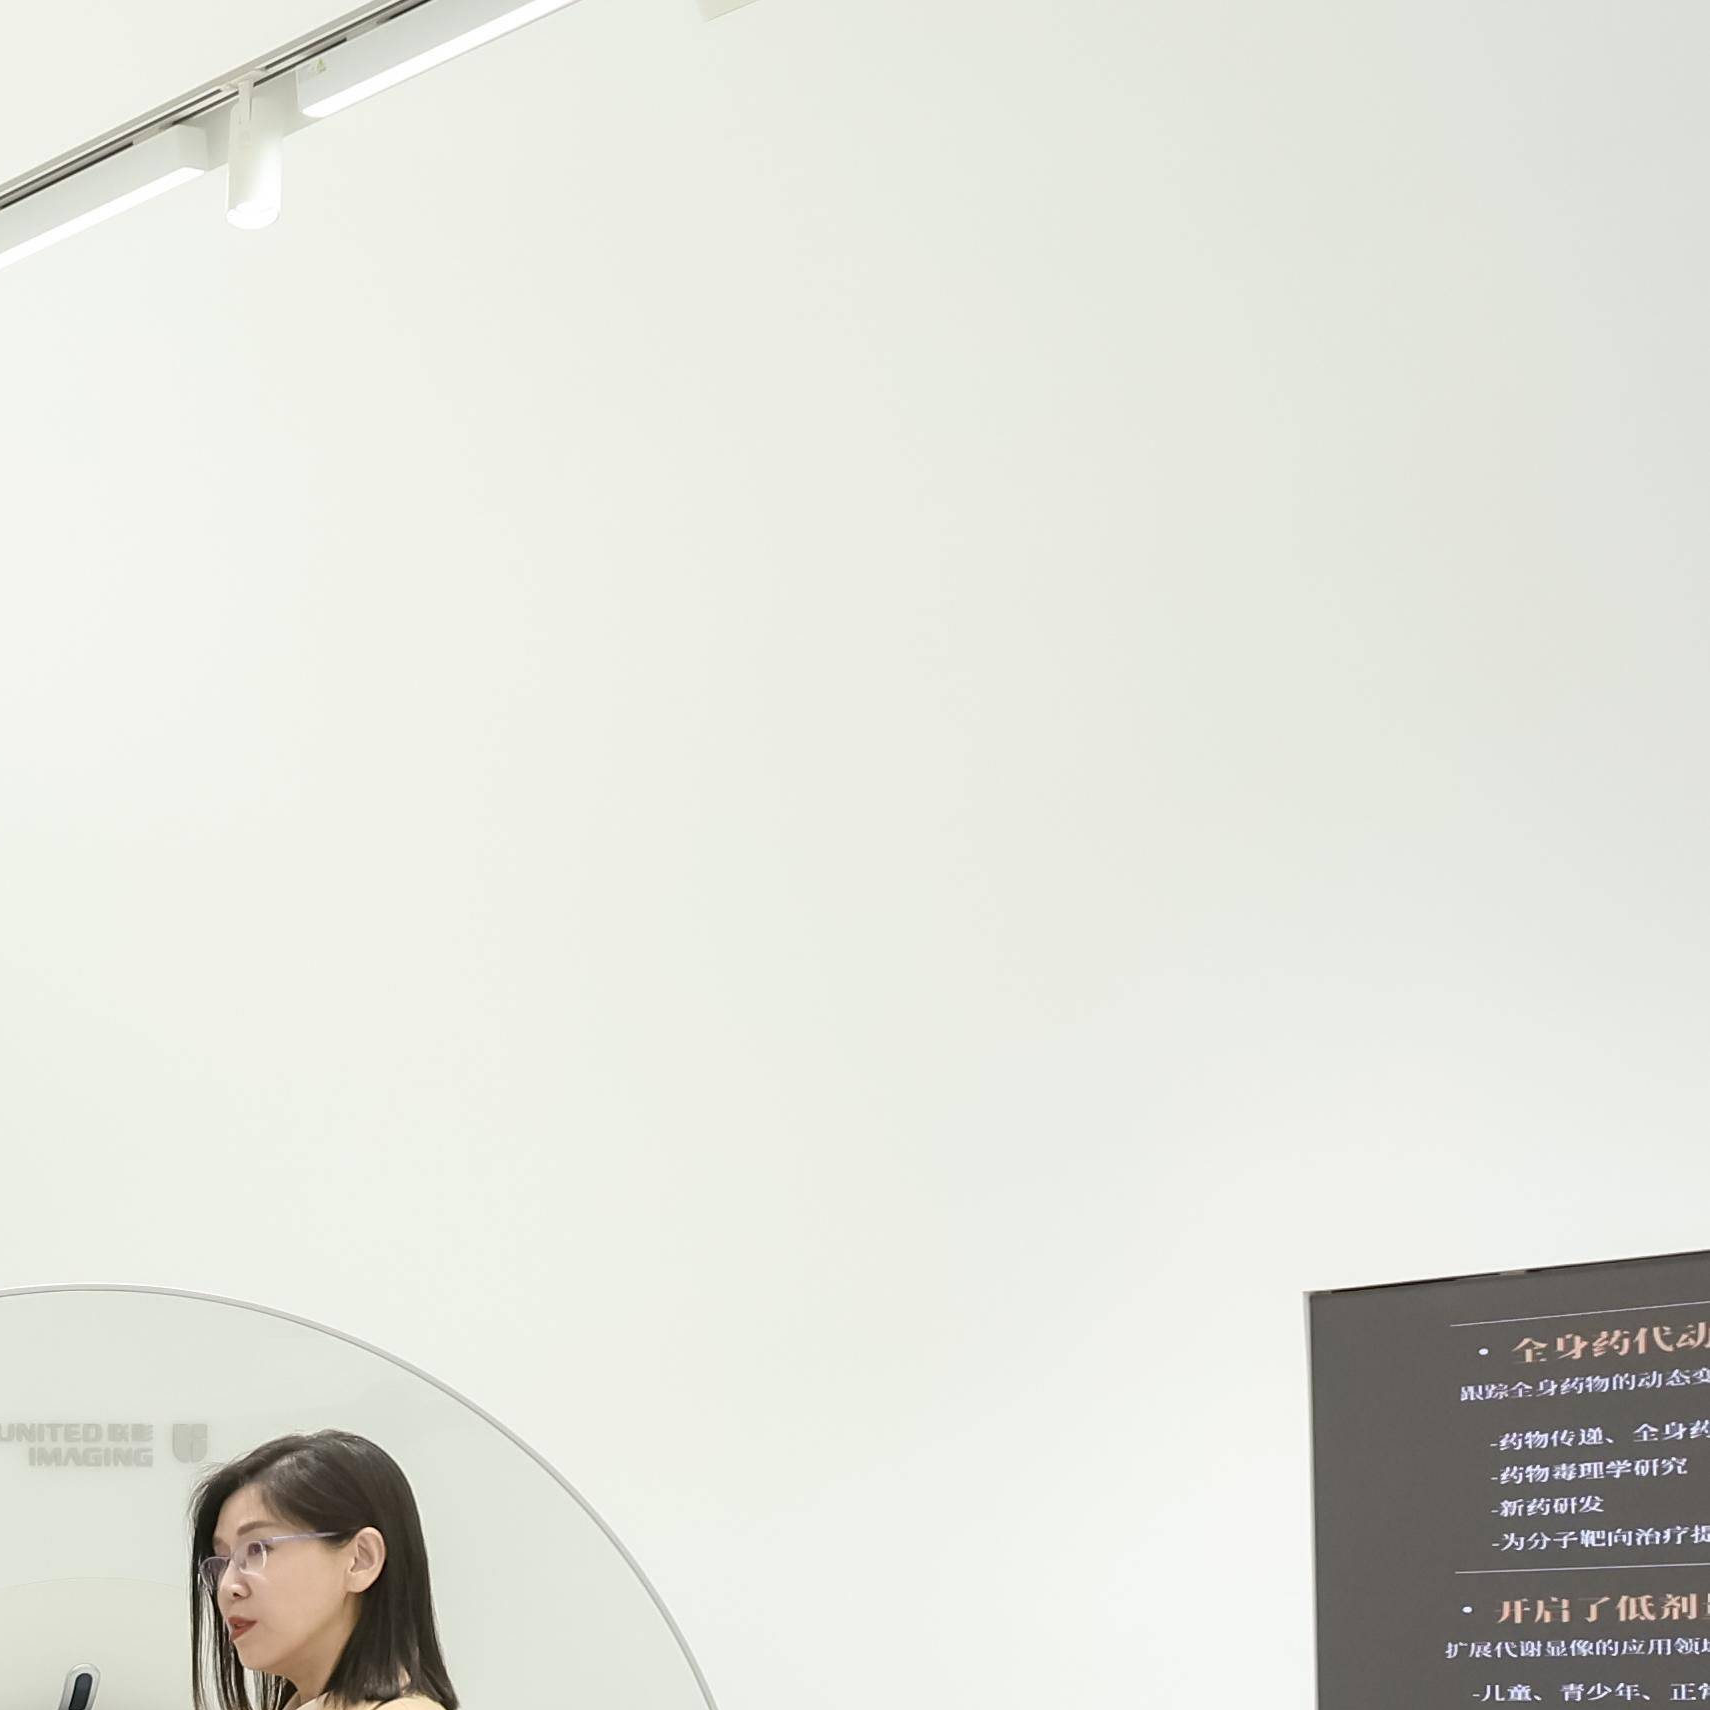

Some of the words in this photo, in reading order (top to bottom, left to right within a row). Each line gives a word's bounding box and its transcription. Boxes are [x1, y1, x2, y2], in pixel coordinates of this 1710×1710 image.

[28, 1447, 154, 1468] IMAGING
[1497, 1592, 1710, 1625] 开启了低剂
